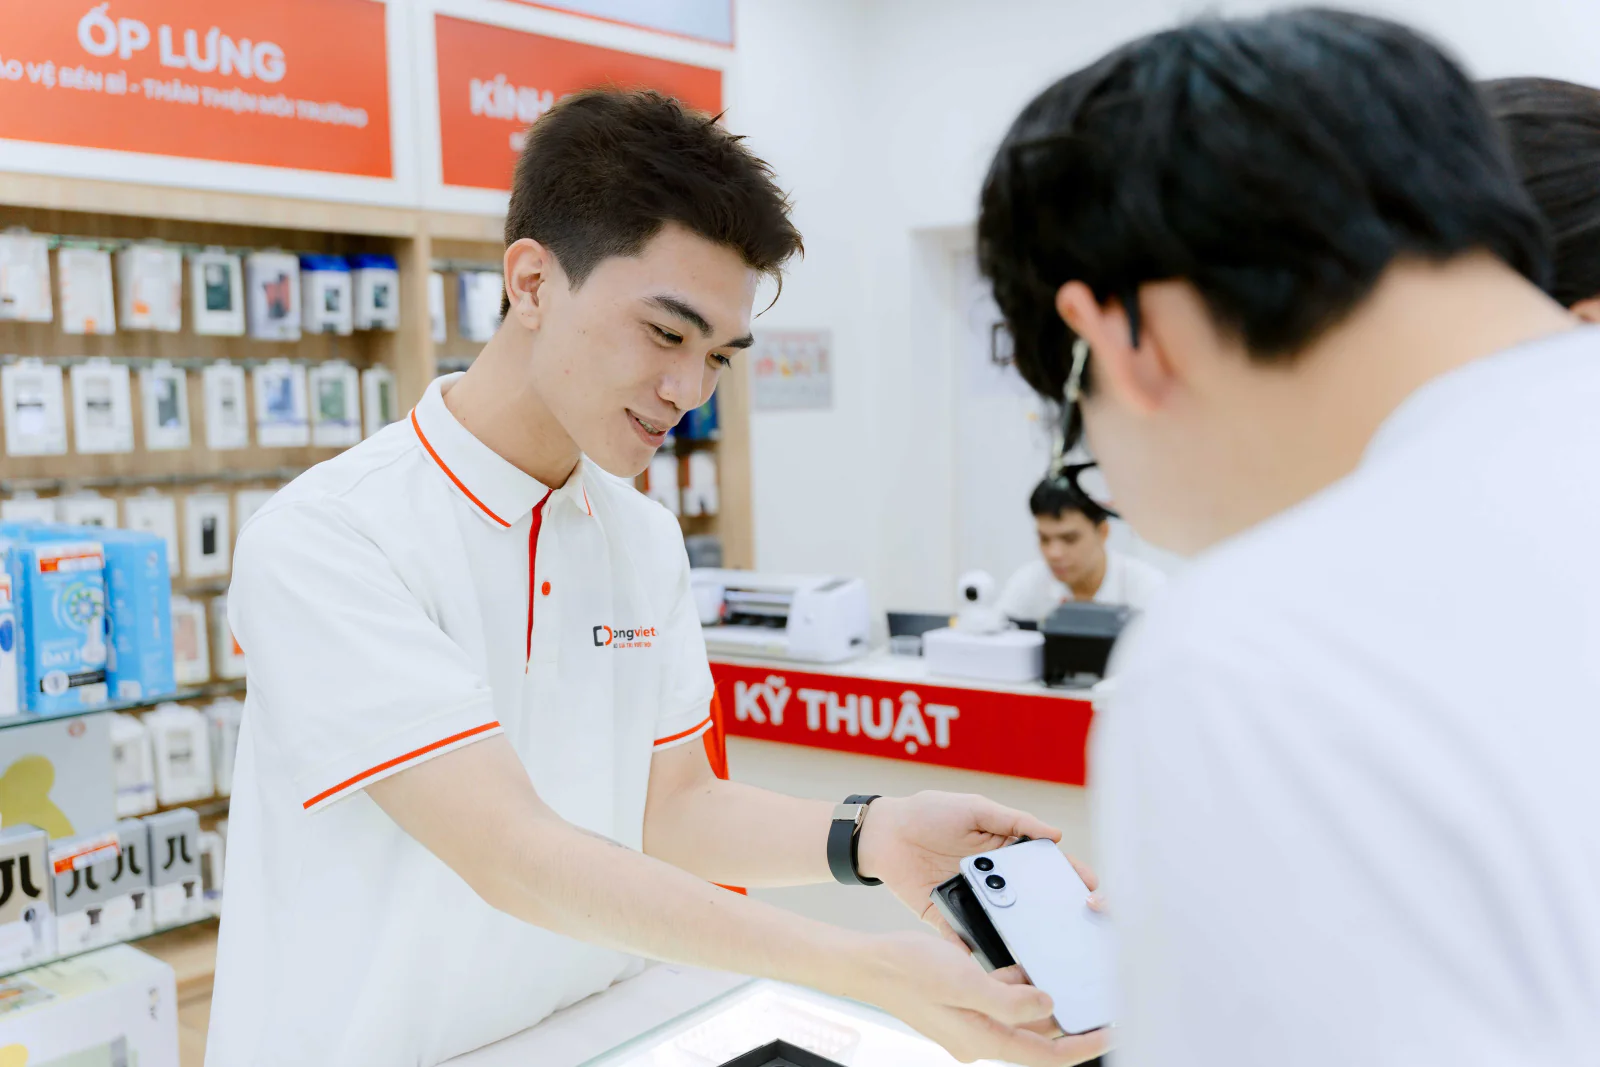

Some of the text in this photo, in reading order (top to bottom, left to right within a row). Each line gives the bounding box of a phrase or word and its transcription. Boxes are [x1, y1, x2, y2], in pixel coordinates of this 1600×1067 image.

[77, 2, 286, 83] ỐP LƯNG
[734, 675, 960, 754] KỸ THUẬT
